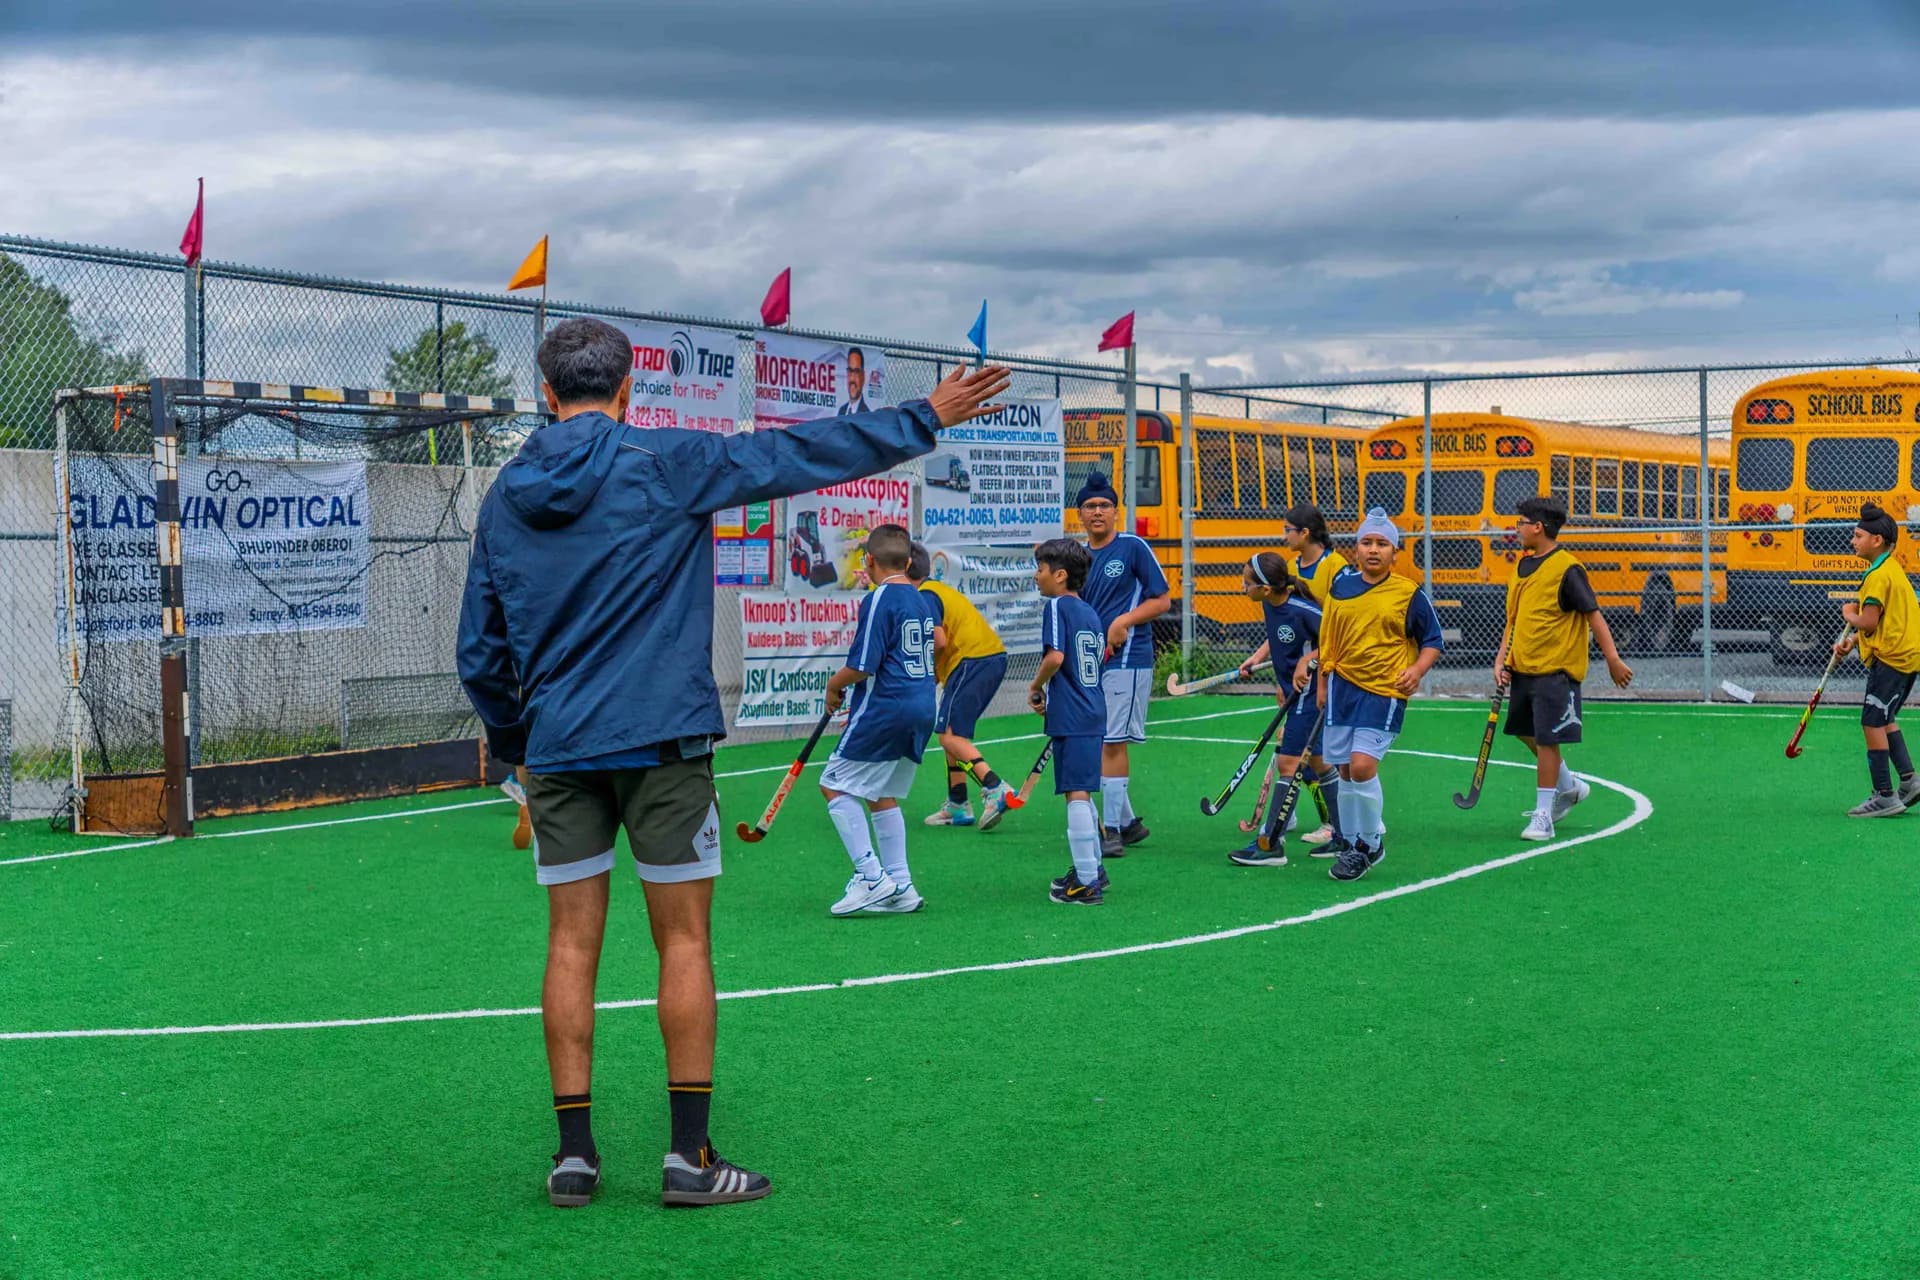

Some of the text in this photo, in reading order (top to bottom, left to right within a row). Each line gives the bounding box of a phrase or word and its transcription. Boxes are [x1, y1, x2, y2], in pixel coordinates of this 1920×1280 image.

[632, 346, 664, 371] TRO
[755, 354, 836, 393] MORTGAGE
[634, 380, 671, 396] choice
[673, 382, 688, 397] for
[781, 389, 790, 403] TO
[791, 391, 816, 405] CHANGE
[1807, 394, 1902, 416] SCHOOL BUS
[949, 429, 1058, 442] FORCE TRANSPORTATION LTD.
[1064, 420, 1123, 442] OOL BUS
[1416, 433, 1486, 453] SHOOL BUS
[979, 479, 1002, 490] REEFER
[1004, 479, 1015, 490] AND
[1017, 479, 1028, 490] DRY
[1029, 479, 1041, 490] VAN
[970, 492, 986, 504] LONG
[1004, 492, 1015, 504] USA
[1023, 492, 1045, 504] CANADA
[1827, 495, 1882, 504] DO NOT PASS
[236, 495, 361, 529] OPTICAL
[819, 509, 827, 526] &
[832, 507, 864, 527] Drain
[925, 507, 1060, 528] 604-621-0063, 604-300-0502
[1834, 505, 1858, 514] WHEN
[73, 541, 158, 558] YE GLASSE
[238, 538, 351, 554] BHUPINDER OBEROI
[1016, 556, 1037, 570] HEA
[1812, 559, 1871, 569] LIGHTS FLASH
[63, 564, 160, 582] ONTACT LE
[957, 575, 1037, 594] & WELLNESS CEN
[63, 586, 163, 605] UNGLASSES
[249, 608, 285, 624] Surrey:
[744, 598, 796, 625] Iknoop's
[800, 599, 848, 624] Trucking
[64, 611, 224, 632] bbotsford: 6044-8803
[747, 631, 782, 648] Kuldeep
[785, 631, 807, 647] Bassi:
[744, 668, 768, 694] JSK
[787, 699, 810, 716] Bassi:
[1230, 752, 1258, 792] ALFA
[765, 793, 785, 823] ALFA
